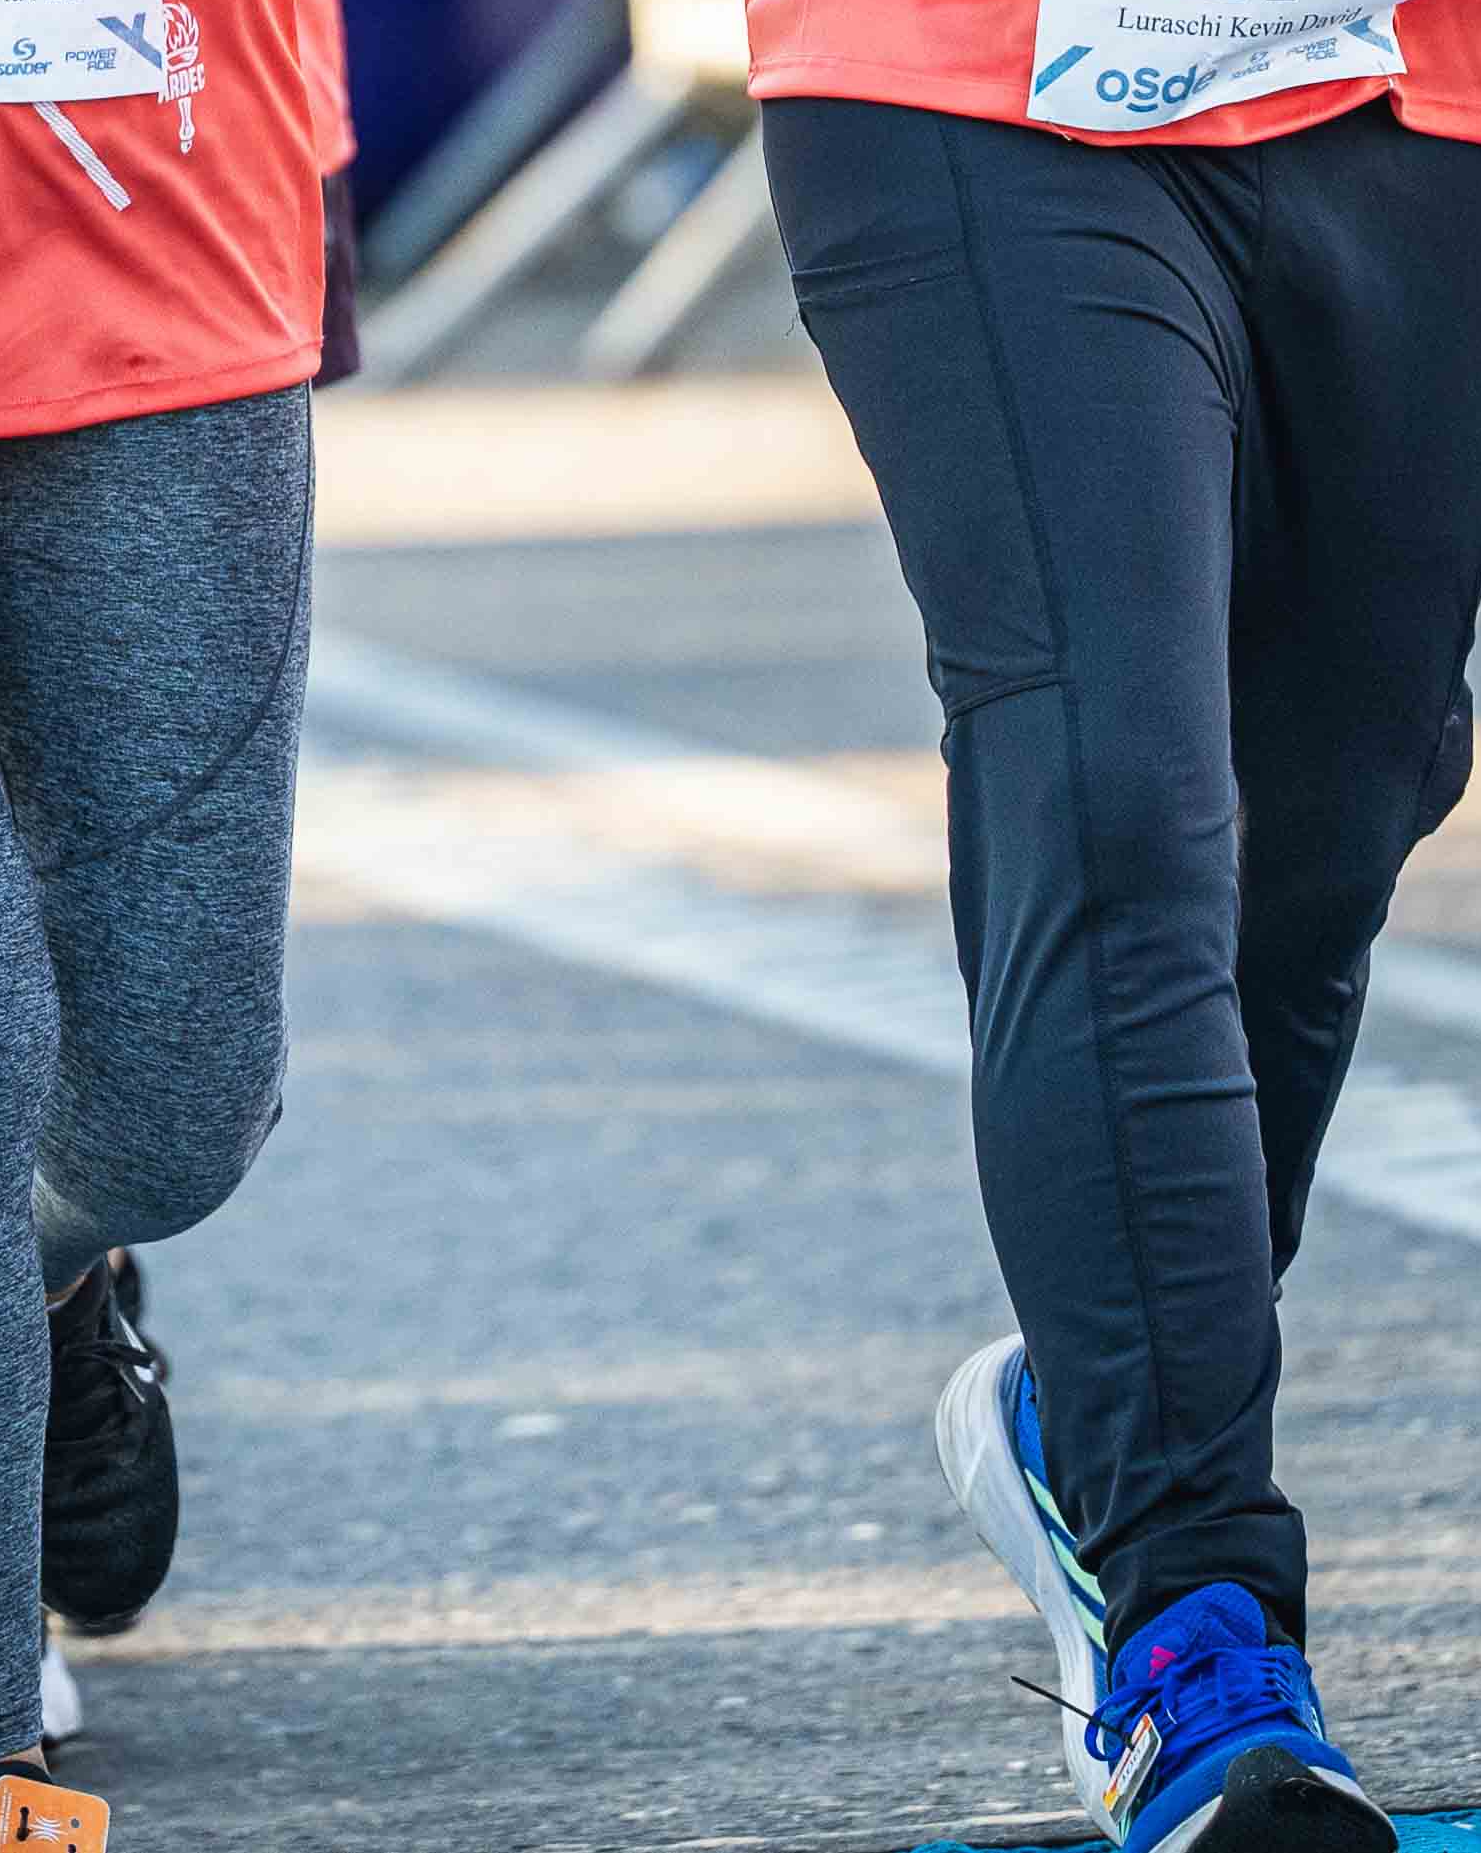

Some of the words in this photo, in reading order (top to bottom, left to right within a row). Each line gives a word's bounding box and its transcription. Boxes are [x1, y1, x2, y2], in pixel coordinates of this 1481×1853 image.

[1116, 7, 1223, 39] Luraschi
[1230, 16, 1294, 39] Kevin
[1299, 7, 1364, 32] David
[65, 48, 116, 62] POWER
